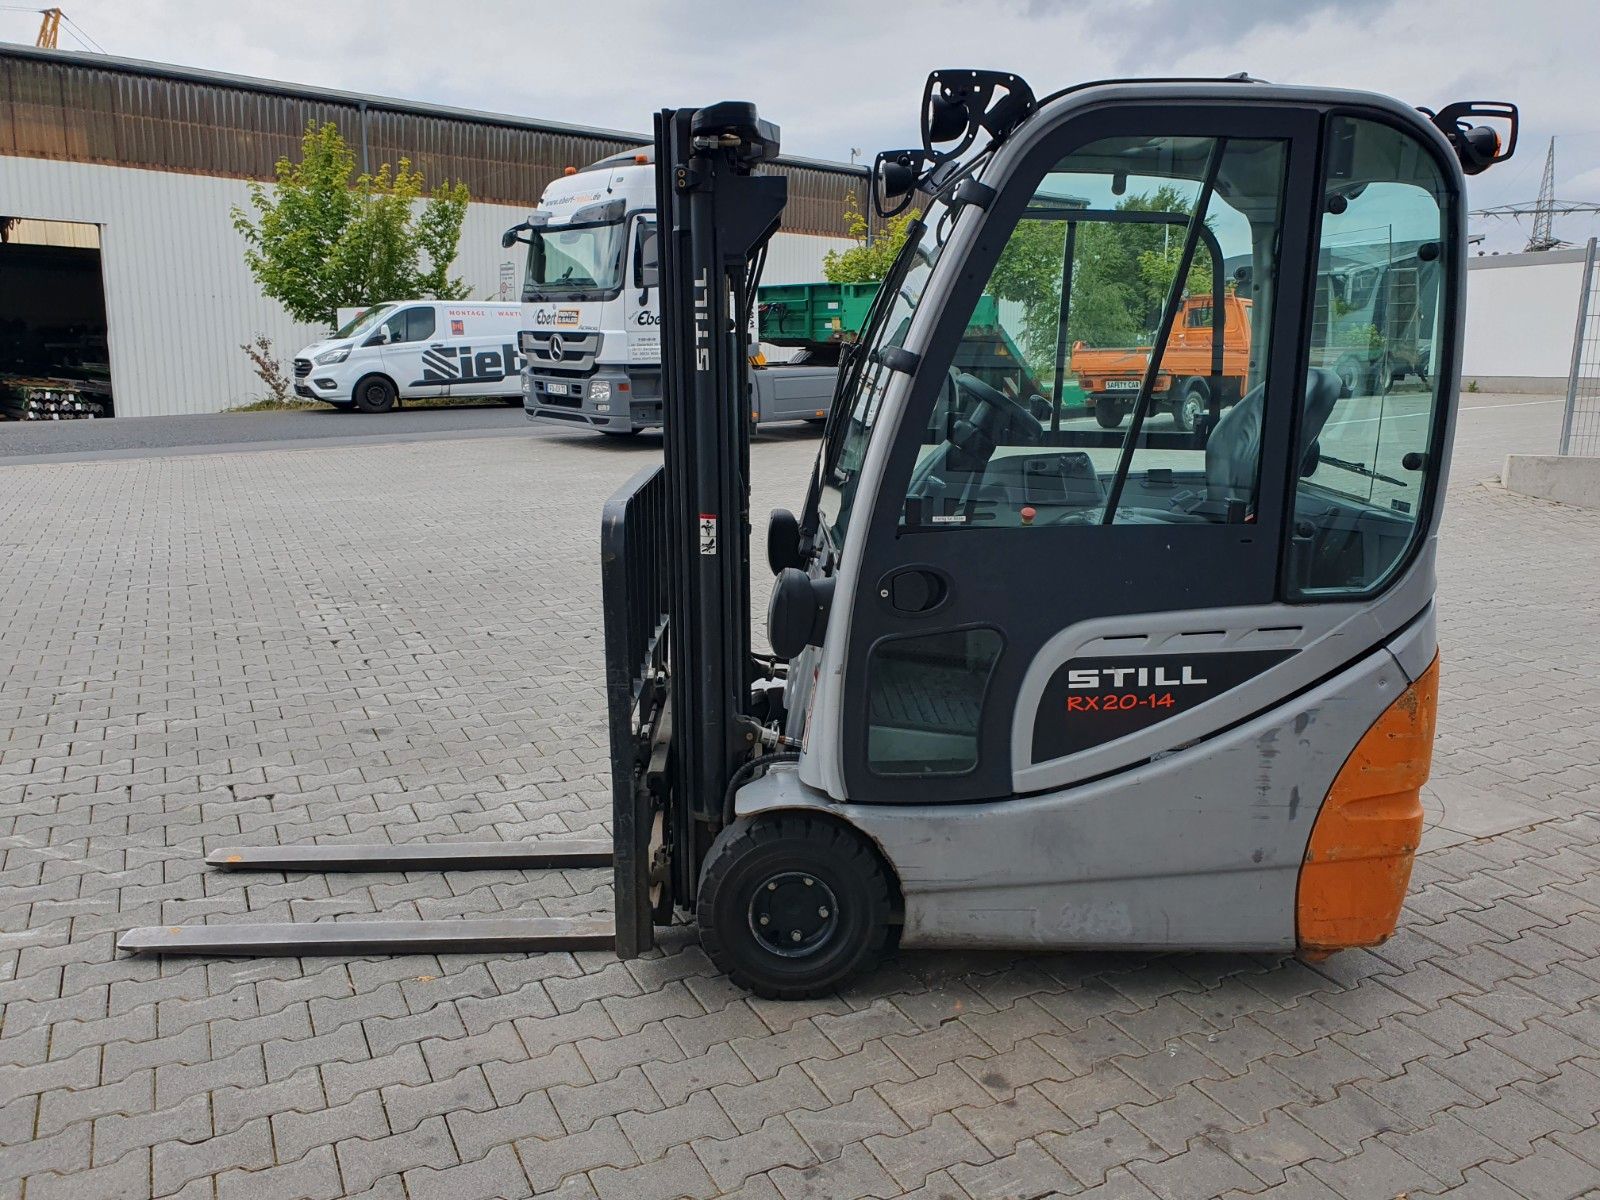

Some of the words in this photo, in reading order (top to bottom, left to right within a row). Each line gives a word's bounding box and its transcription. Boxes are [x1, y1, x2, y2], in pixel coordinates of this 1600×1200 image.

[537, 309, 557, 325] Ebert
[694, 267, 710, 371] STILL
[1107, 381, 1127, 389] SAFETY
[1128, 381, 1139, 389] CAR
[1068, 666, 1207, 688] STILL
